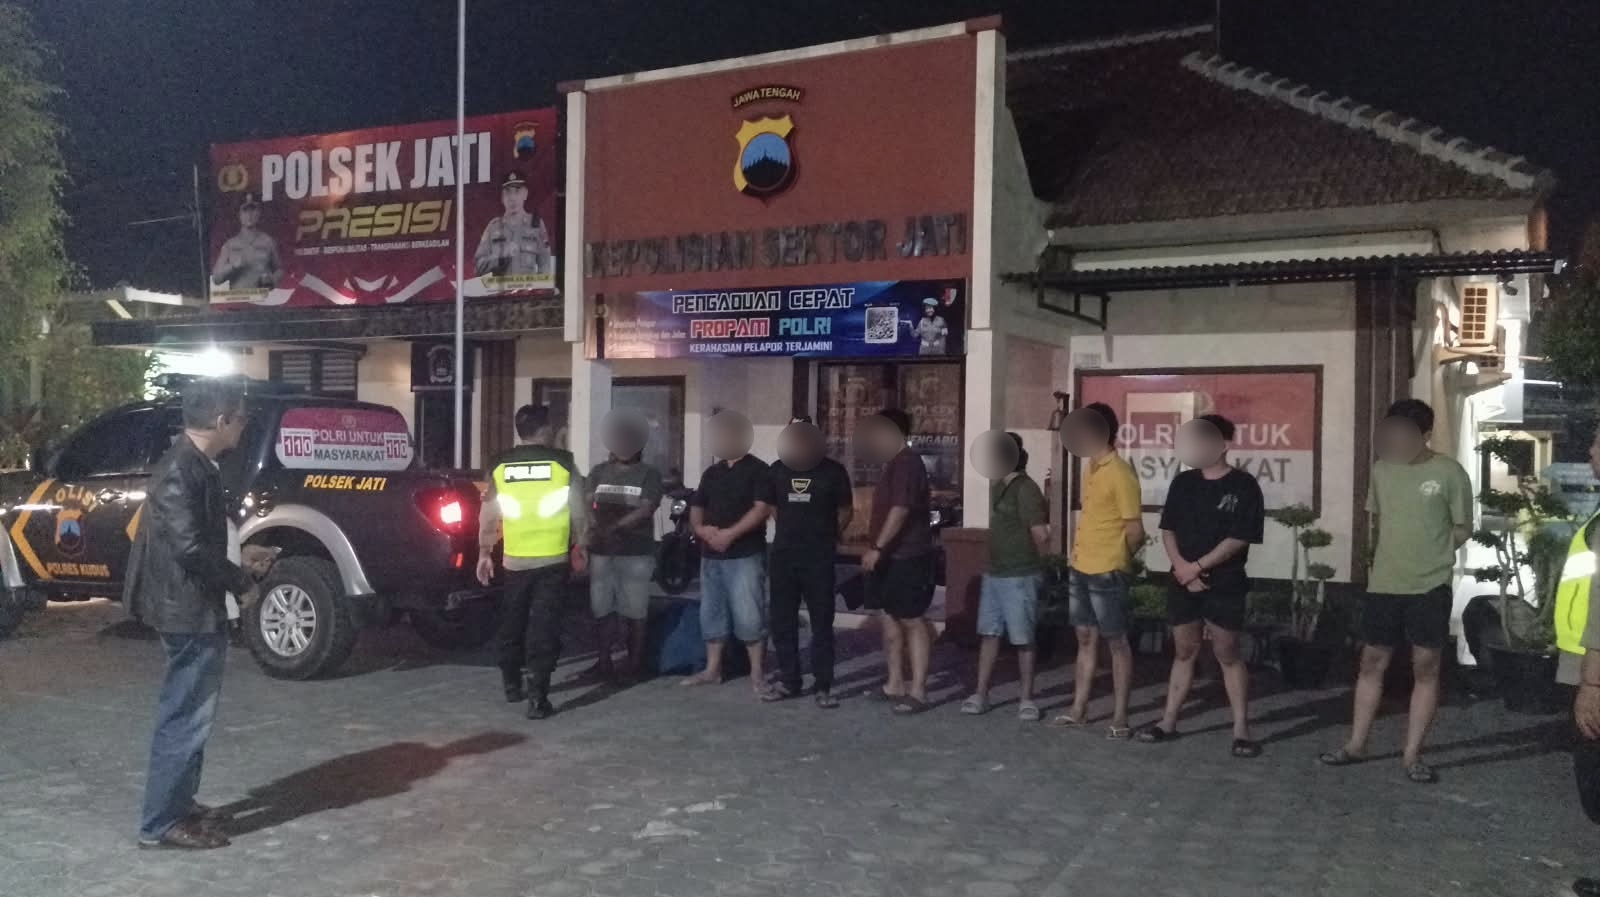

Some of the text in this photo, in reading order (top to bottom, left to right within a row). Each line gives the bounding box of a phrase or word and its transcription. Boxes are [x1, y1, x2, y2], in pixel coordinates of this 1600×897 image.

[733, 87, 801, 107] JAWA TENGAH
[261, 131, 491, 202] POLSEK JATI
[296, 199, 452, 241] PRESISI
[761, 221, 887, 267] SEKTOR
[896, 214, 967, 258] JATI
[672, 287, 855, 314] PENGADUAN CEPAT
[690, 317, 770, 339] PROPAM
[778, 316, 832, 336] POLRI
[689, 343, 742, 353] KERAHASIAN
[744, 342, 783, 352] PELAPOR
[312, 429, 347, 442] POLRI
[284, 437, 312, 456] 110
[314, 447, 384, 461] MASYARAKAT
[385, 440, 407, 458] 110
[303, 474, 387, 491] POLSEK JATI
